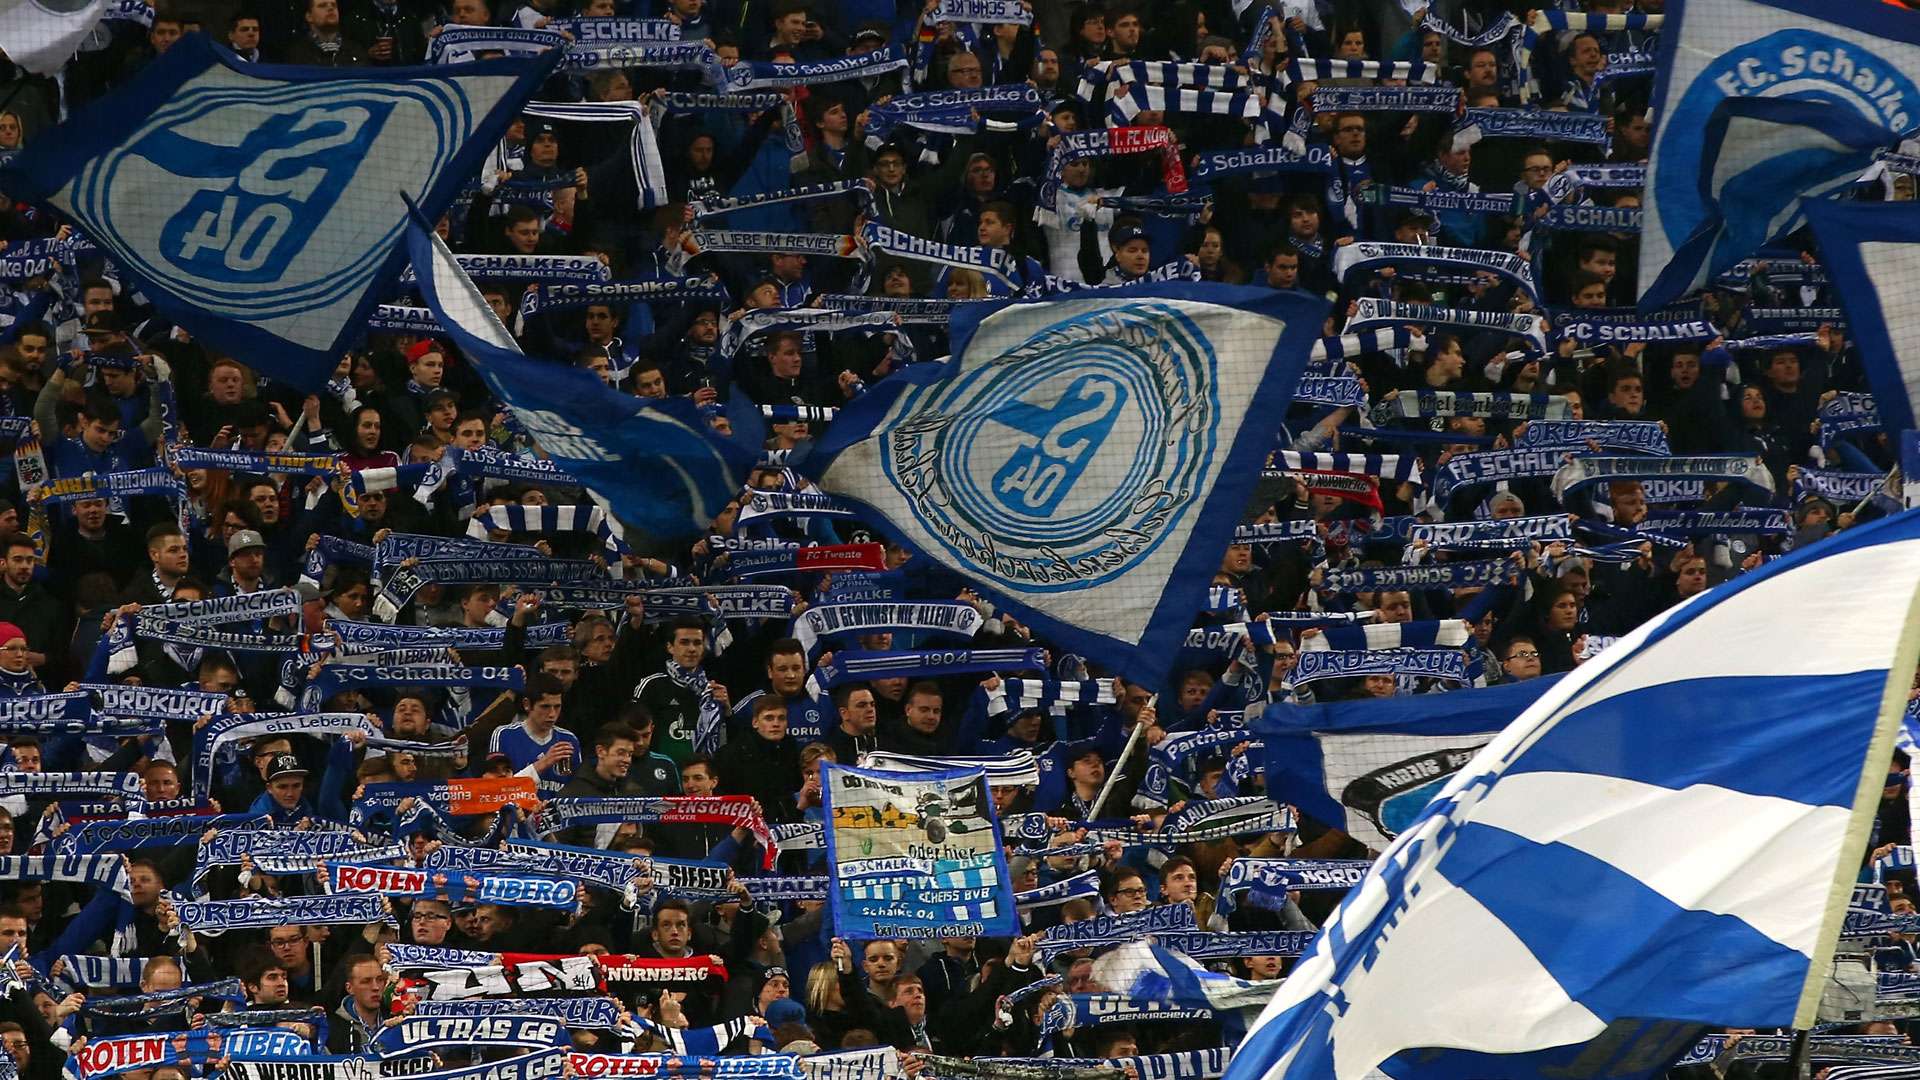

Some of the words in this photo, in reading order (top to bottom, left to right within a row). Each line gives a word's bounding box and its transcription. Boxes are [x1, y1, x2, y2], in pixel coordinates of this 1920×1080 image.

[581, 21, 681, 41] SCHALKE
[801, 56, 869, 75] Schalke
[1781, 46, 1908, 133] Schalke
[893, 96, 925, 112] FC
[929, 87, 1020, 107] Schalke
[1465, 197, 1512, 212] VEREIN
[1564, 207, 1643, 227] SCHALK
[722, 233, 760, 246] LIEBE
[786, 236, 836, 249] REVIER
[877, 226, 983, 265] SCHALKE
[459, 255, 566, 271] SCHALKE
[569, 258, 597, 271] 04
[547, 284, 579, 298] FC
[587, 278, 677, 297] Schalke
[1563, 323, 1593, 339] FC
[1600, 321, 1709, 341] SCHALKE
[1480, 453, 1565, 476] SCHALK
[708, 534, 800, 551] Schalke
[1412, 524, 1475, 543] ORD
[806, 550, 822, 561] FC
[824, 549, 862, 560] Twente
[1373, 568, 1453, 585] SCHALKE
[719, 598, 786, 612] ALKE
[834, 589, 892, 602] CHALKE
[841, 605, 893, 629] GEWINNST
[897, 605, 912, 625] NIE
[917, 605, 955, 627] ALLEIN!
[924, 650, 968, 666] 1904
[1299, 651, 1362, 674] ORD
[331, 668, 369, 682] FC
[376, 664, 473, 681] Schalke
[481, 667, 510, 680] 04
[266, 720, 292, 733] ein
[297, 715, 352, 730] Leben
[1168, 729, 1231, 761] Partner
[80, 796, 196, 814] TRATION
[428, 790, 471, 801] EUROPA
[508, 791, 537, 801] OUND
[677, 799, 752, 817] ENSCHED
[1207, 799, 1236, 817] UND
[428, 848, 500, 869] ORD
[859, 857, 917, 872] SCHALKE
[337, 866, 426, 892] ROTEN
[668, 864, 729, 889] SIEGE
[481, 876, 576, 903] LIBERO
[918, 890, 960, 904] SCHEISS
[964, 888, 990, 901] BVB
[183, 902, 251, 925] ORD
[295, 895, 382, 921] KURV
[916, 909, 935, 921] 04
[608, 962, 708, 982] NÜRNBERG
[401, 1017, 512, 1044] ULTRAS
[77, 1035, 168, 1079] ROTEN
[570, 1054, 660, 1078] ROTEN
